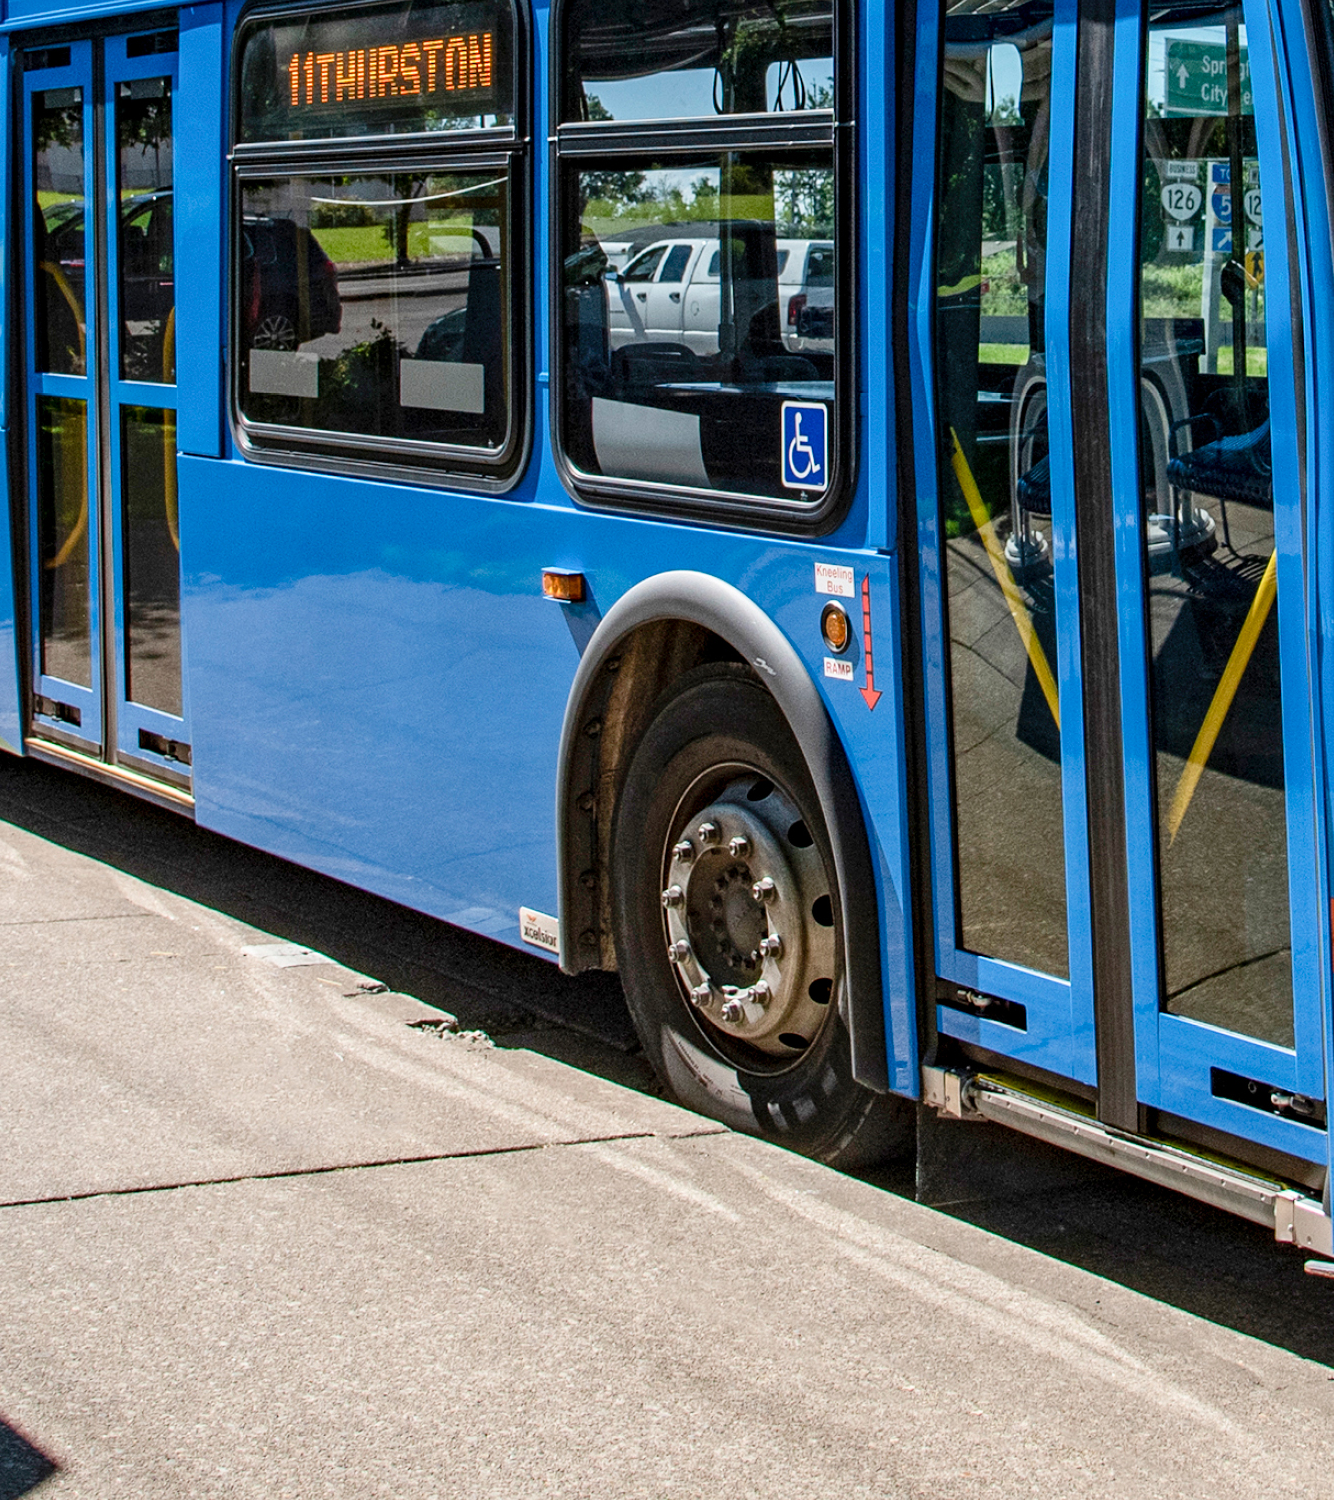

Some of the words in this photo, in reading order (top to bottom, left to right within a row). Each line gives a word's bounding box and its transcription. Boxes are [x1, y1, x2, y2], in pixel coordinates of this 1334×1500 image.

[1201, 83, 1229, 106] City
[1169, 162, 1196, 175] BUSINESS
[1168, 189, 1195, 210] 126
[816, 564, 853, 584] Kneeling
[827, 581, 844, 594] Bus
[825, 662, 851, 676] RAMP
[524, 926, 557, 947] xcelsior
